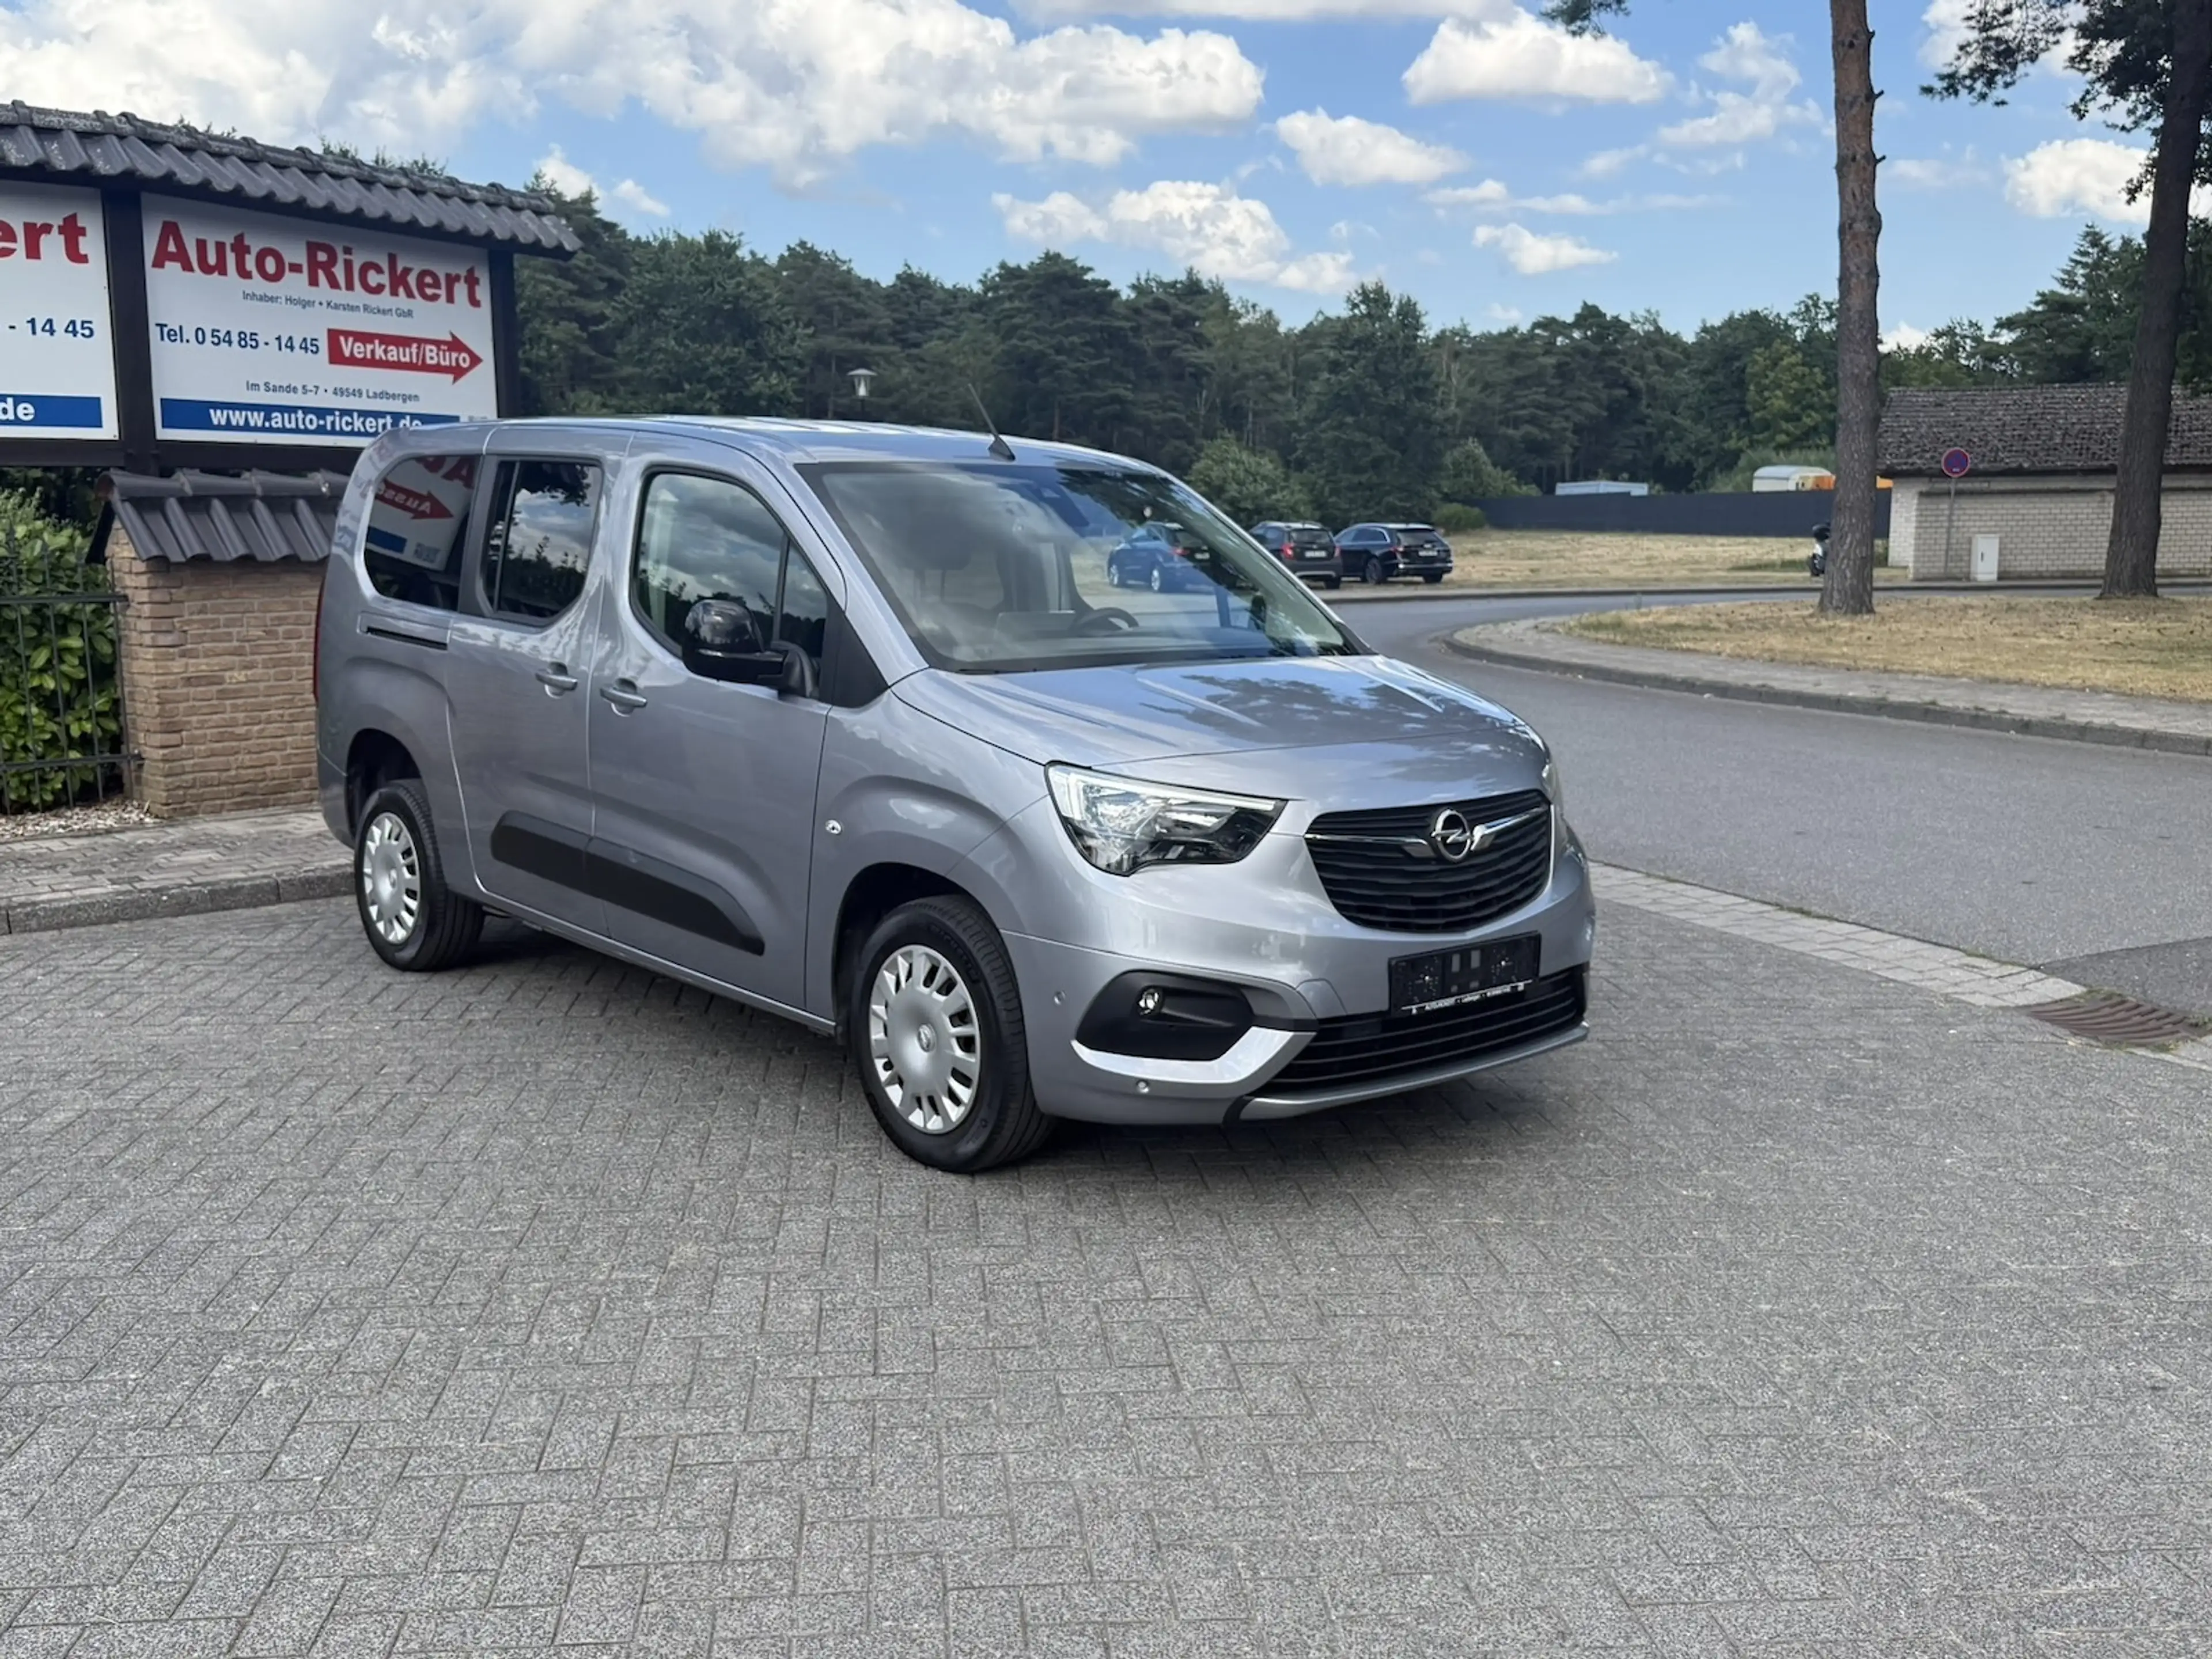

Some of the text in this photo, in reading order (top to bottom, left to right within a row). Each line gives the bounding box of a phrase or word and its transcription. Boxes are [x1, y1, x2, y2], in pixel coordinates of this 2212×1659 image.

[151, 221, 482, 308] Auto-Rickert
[242, 290, 282, 304] Inhaber:
[285, 294, 316, 309] Holger
[326, 300, 361, 313] Karsten
[362, 304, 393, 316] Rickert
[395, 308, 414, 319] GbR
[26, 317, 56, 336] 14
[65, 319, 94, 339] 45
[155, 323, 190, 344] Tel.
[195, 327, 206, 345] 0
[211, 328, 233, 348] 54
[237, 331, 259, 349] 85
[275, 334, 295, 352] 14
[299, 337, 320, 354] 45
[339, 335, 471, 368] Verkauf/Büro
[246, 380, 260, 392] Im
[264, 381, 298, 395] Sande
[332, 387, 363, 399] 49549
[366, 389, 420, 404] Ladbergen
[209, 408, 423, 434] www.auto-rickertd
